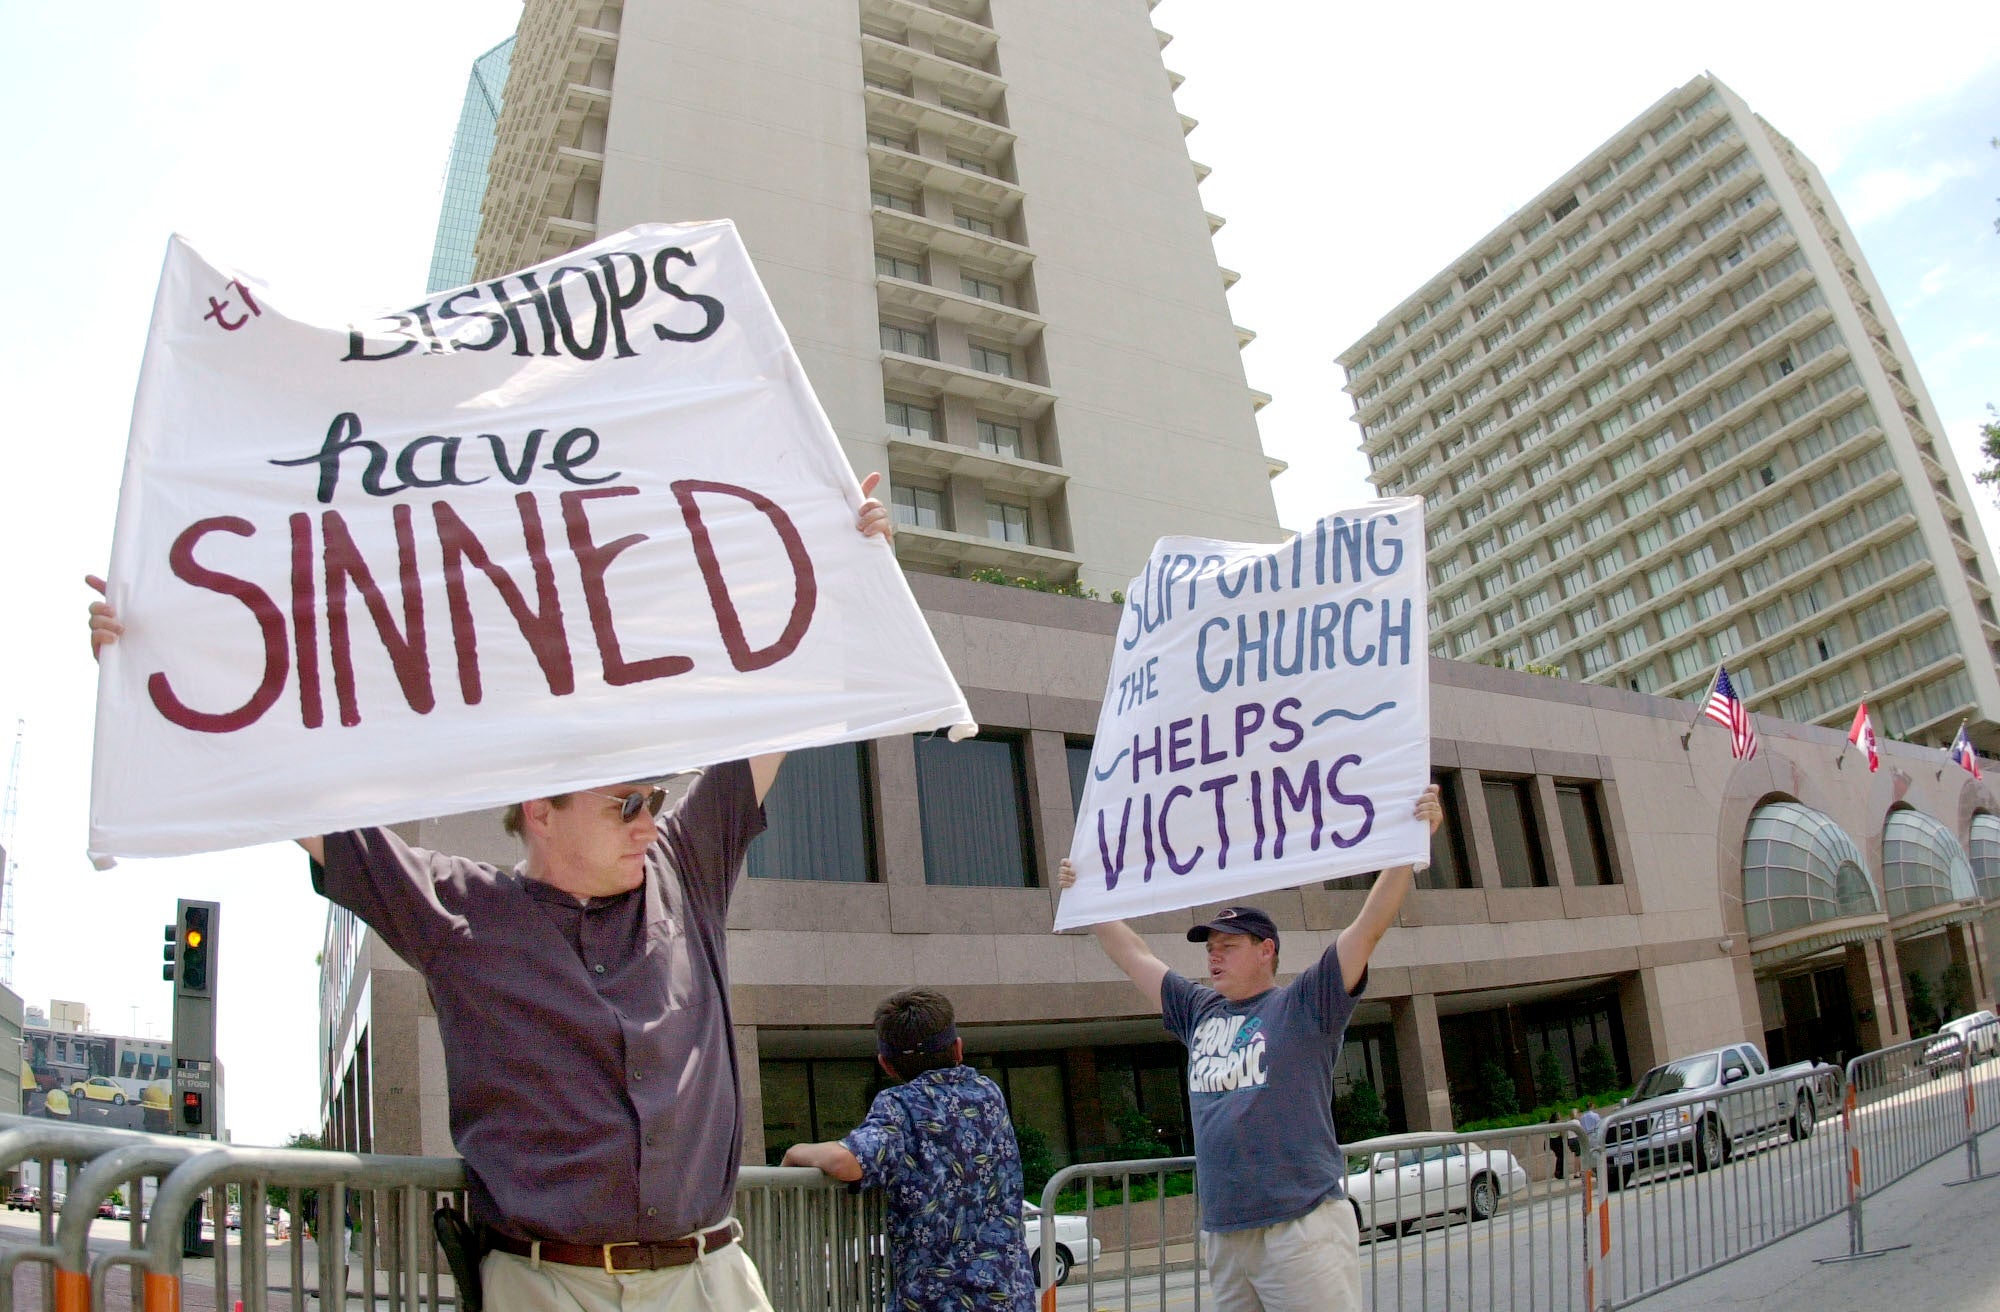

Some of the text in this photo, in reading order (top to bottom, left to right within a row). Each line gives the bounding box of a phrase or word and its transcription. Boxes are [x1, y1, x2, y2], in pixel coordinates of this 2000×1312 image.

[340, 247, 725, 361] BISHOPS
[269, 411, 622, 503] have
[148, 479, 818, 733] SINNED
[1117, 598, 1411, 716] THE CHURCH
[1132, 697, 1304, 783] HELPS
[1098, 754, 1376, 891] VICTIMS
